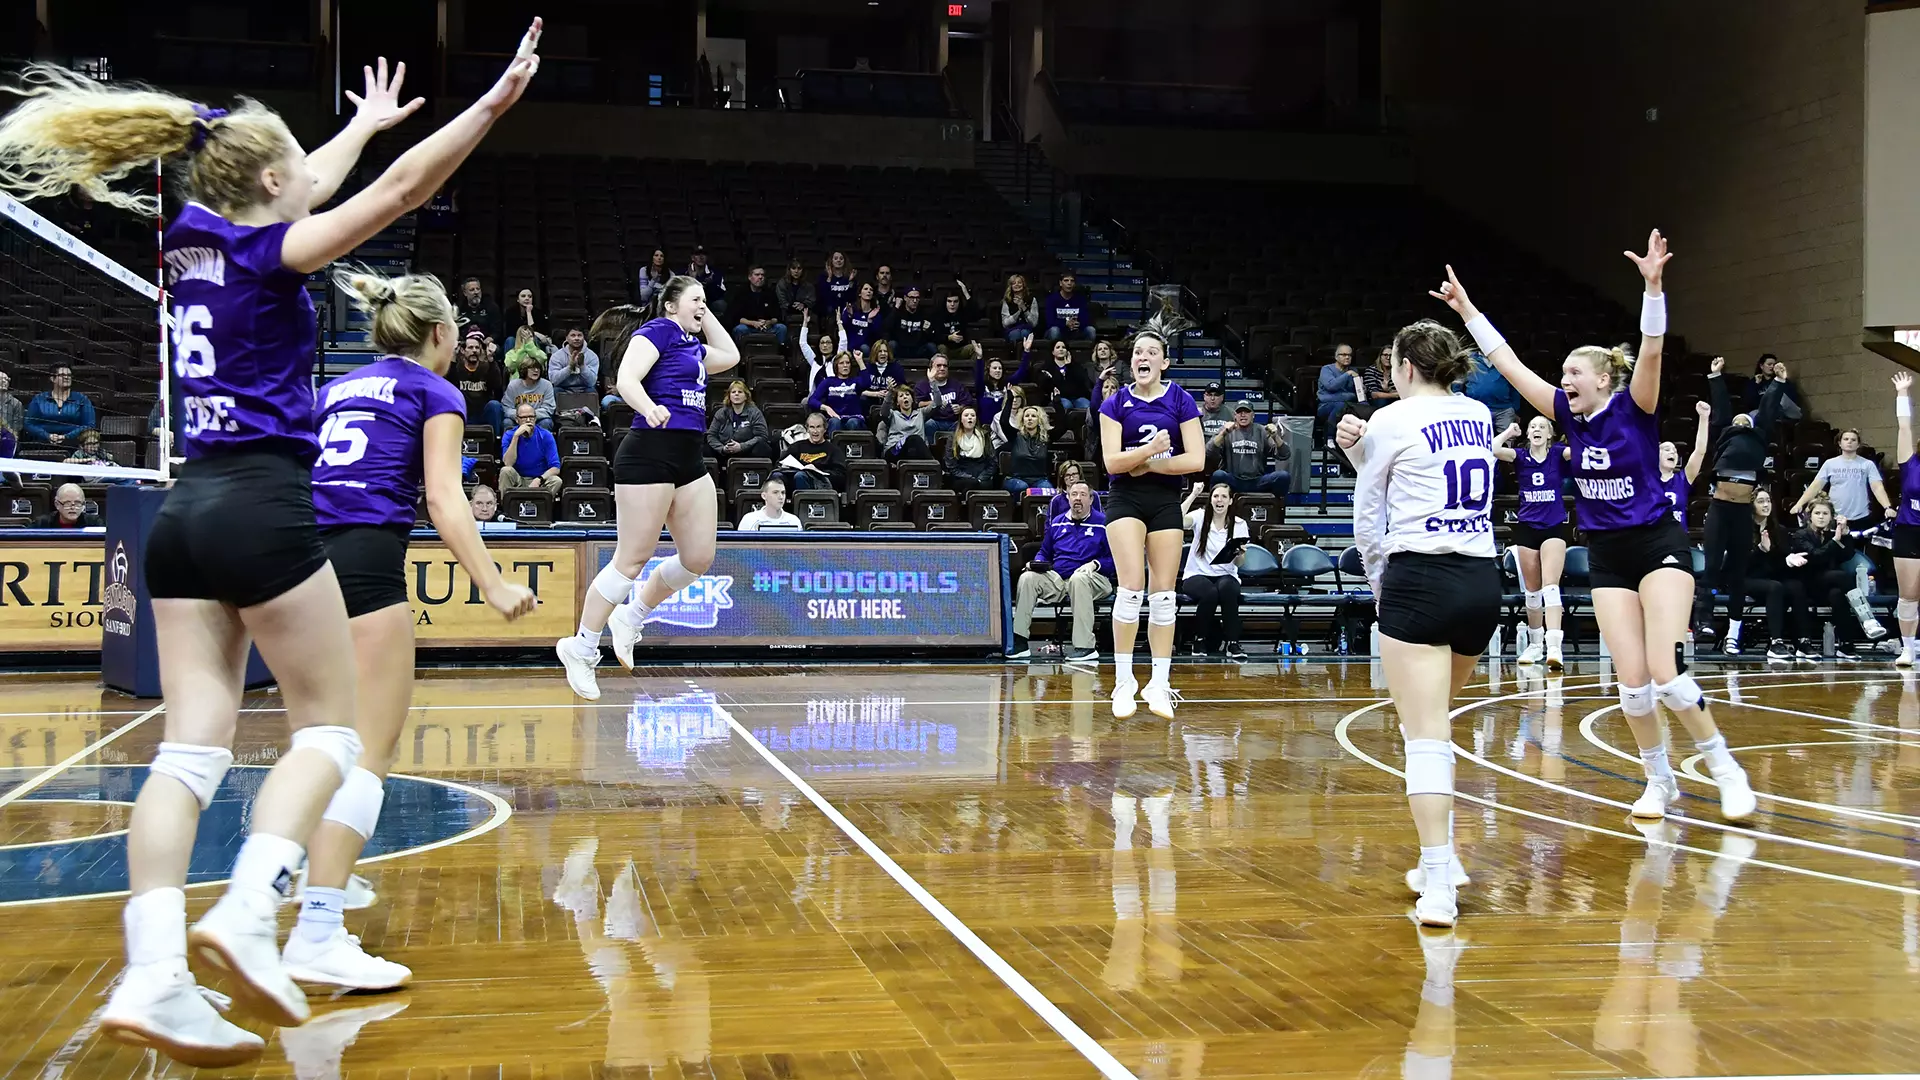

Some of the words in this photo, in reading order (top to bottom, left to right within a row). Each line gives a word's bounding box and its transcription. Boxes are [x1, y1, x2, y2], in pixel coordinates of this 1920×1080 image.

[948, 4, 963, 16] EXIT
[940, 124, 973, 141] 103
[1138, 424, 1158, 443] 2
[1421, 420, 1493, 454] WINONA
[1581, 446, 1611, 470] 19
[1443, 459, 1490, 511] 10
[1532, 472, 1545, 486] 8
[1575, 476, 1634, 500] WARRIORS
[1523, 489, 1555, 502] WARRIORS
[753, 571, 958, 593] #FOODGOALS
[807, 599, 857, 619] START
[861, 599, 906, 619] HERE.
